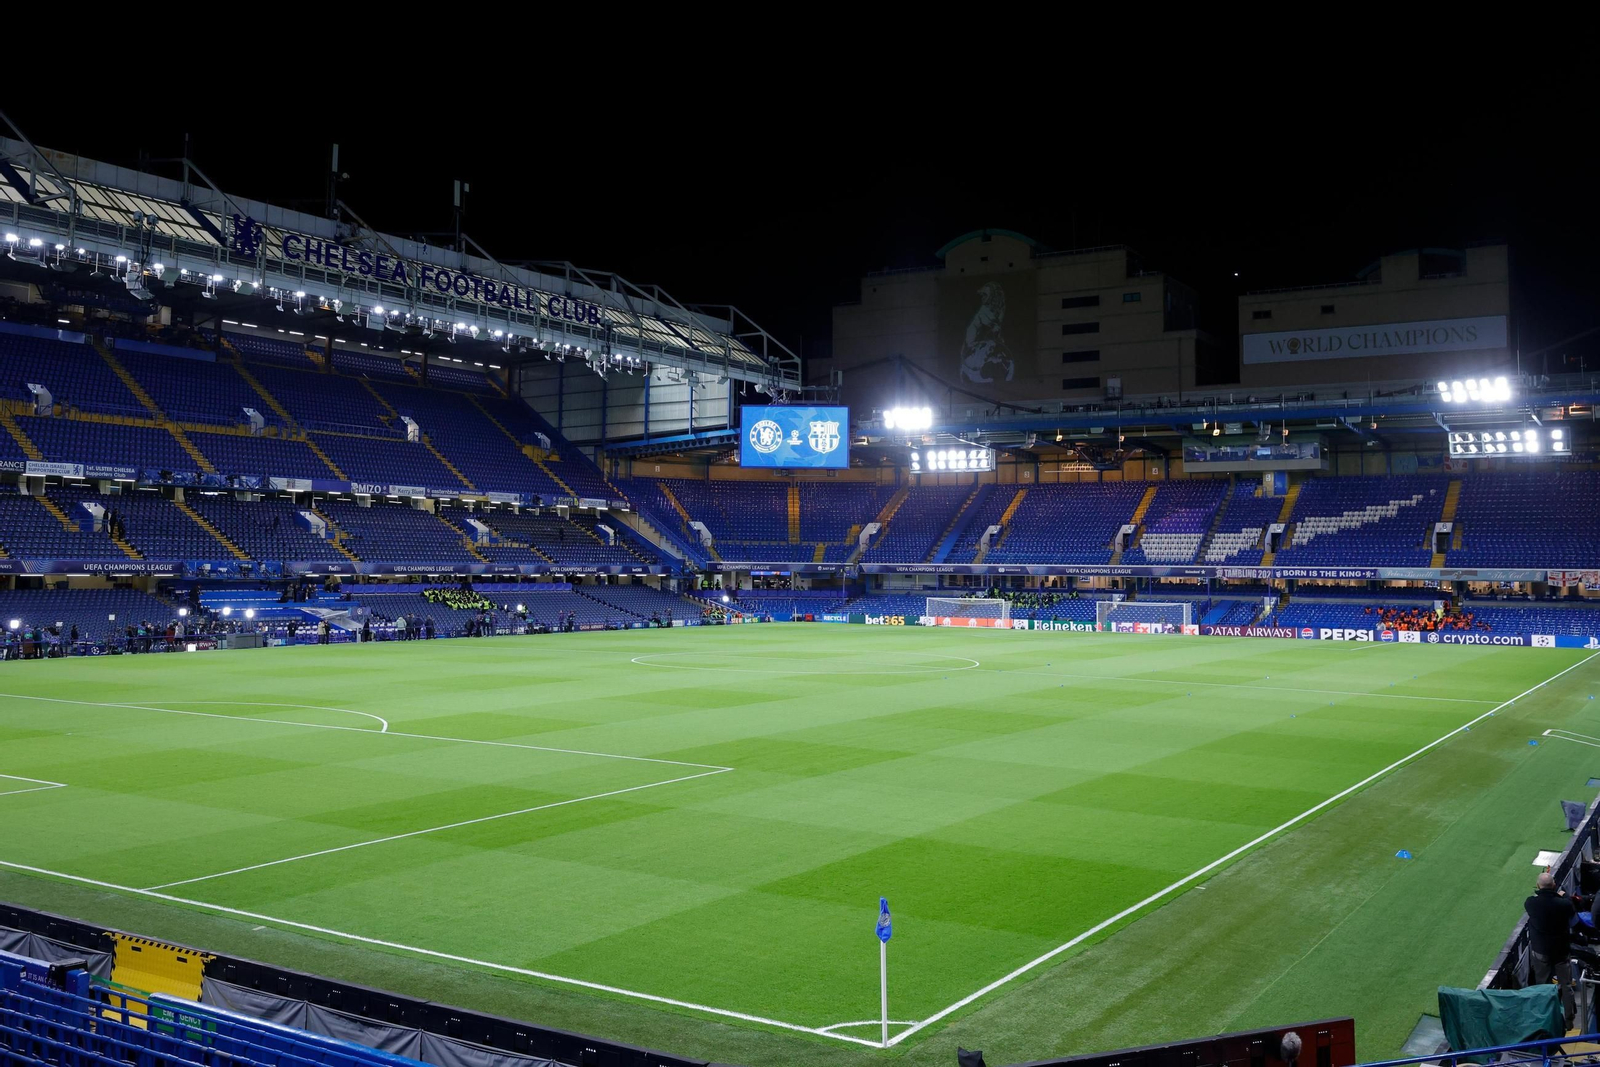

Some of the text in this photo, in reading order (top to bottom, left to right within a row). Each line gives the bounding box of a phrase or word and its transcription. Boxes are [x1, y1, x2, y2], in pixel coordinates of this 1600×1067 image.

[283, 235, 601, 326] CHELSEA FOOTBALL CLUB
[1269, 325, 1478, 355] WORLD CHAMPIONS
[85, 470, 113, 478] Supporters
[358, 483, 382, 494] MIZO
[397, 488, 411, 496] Kerry
[83, 563, 102, 571] UEFA
[1224, 569, 1257, 578] TAMBLING
[865, 614, 905, 626] bet365
[1034, 621, 1093, 631] Heineken
[1245, 627, 1292, 638] AIRWAYS
[1320, 628, 1373, 641] PEPSI
[1443, 633, 1523, 645] crypto.com
[162, 1009, 202, 1026] EMEGENCY
